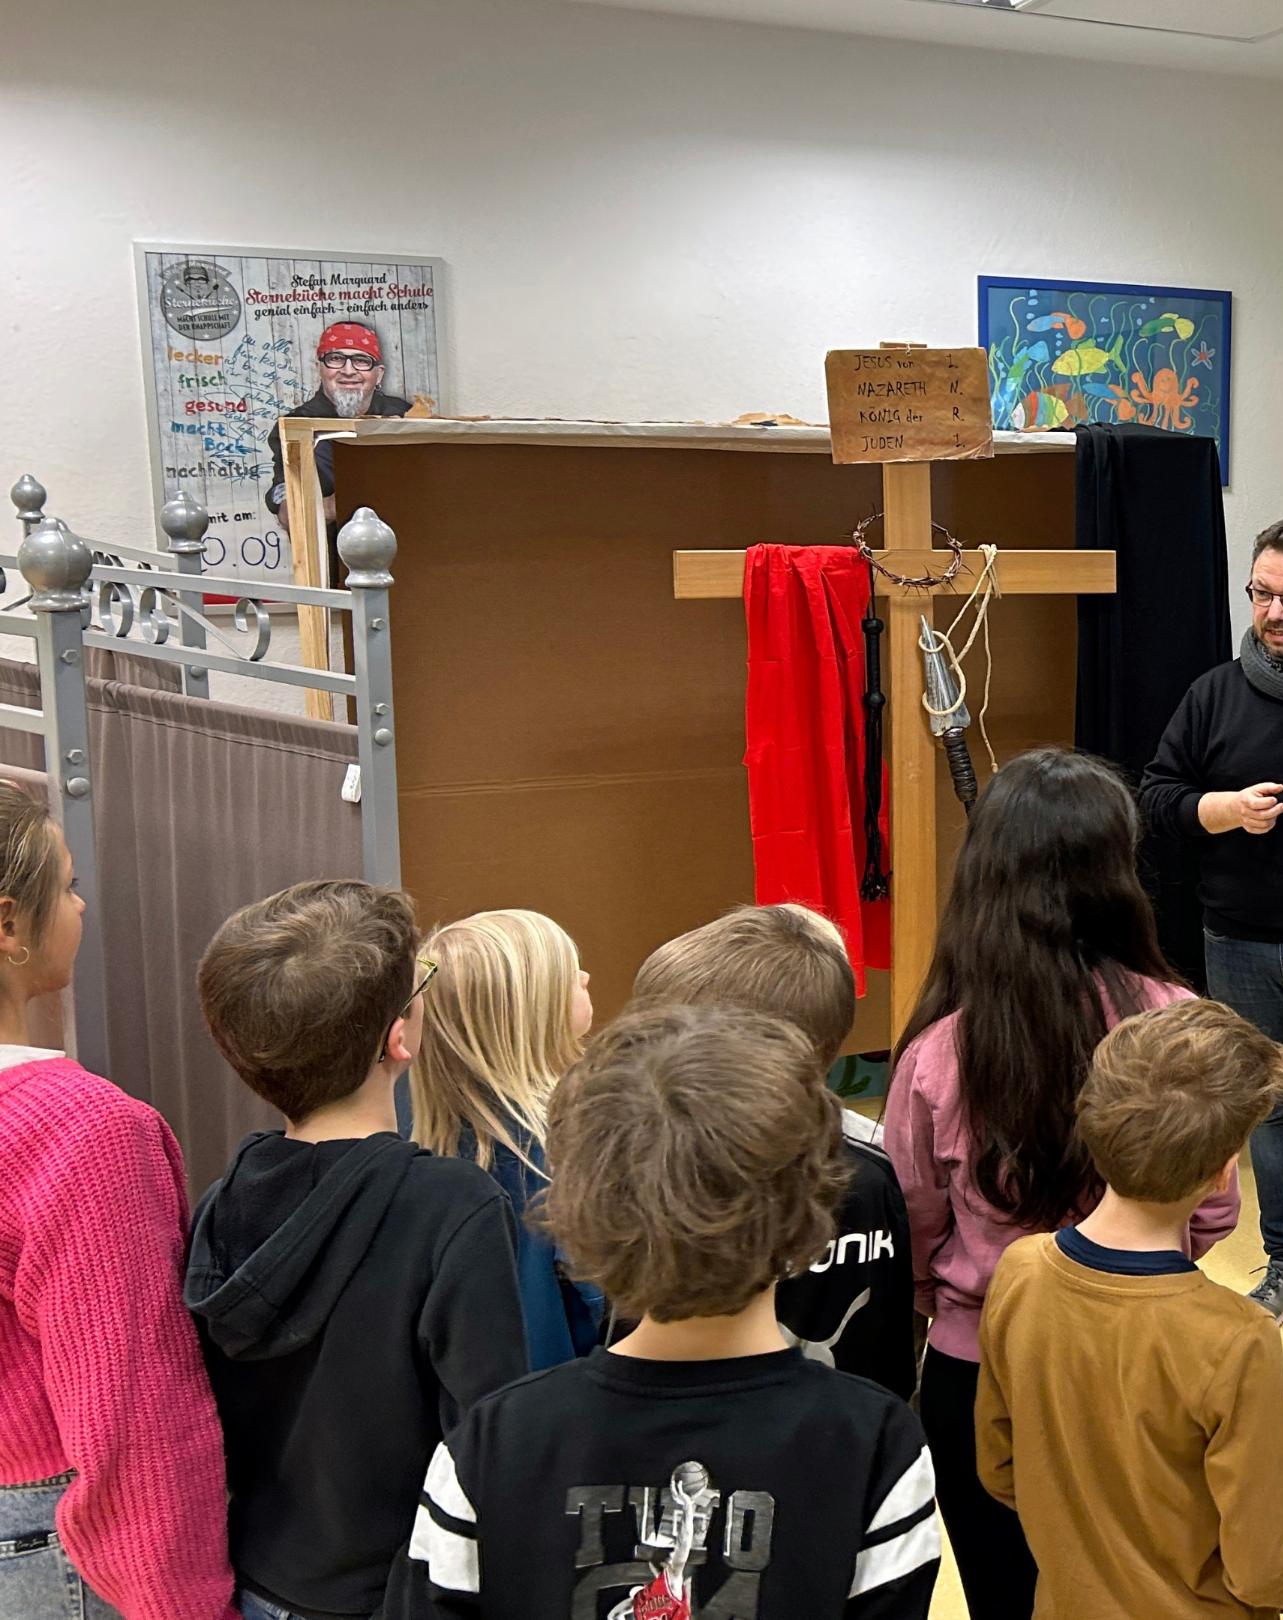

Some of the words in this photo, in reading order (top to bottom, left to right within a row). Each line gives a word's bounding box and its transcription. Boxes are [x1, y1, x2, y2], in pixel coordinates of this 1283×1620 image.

[291, 274, 327, 290] Stefan
[330, 273, 387, 288] Marquard
[245, 288, 336, 306] Sterneküche
[339, 286, 383, 300] macht
[386, 283, 434, 300] Schule
[254, 304, 291, 320] genial
[293, 302, 336, 318] einfach
[346, 301, 387, 316] einfach
[390, 300, 429, 312] anders
[167, 345, 224, 365] lecker
[854, 354, 892, 371] JESUS
[178, 370, 227, 389] frisch
[857, 381, 927, 398] NAZARETH
[185, 398, 247, 416] gesund
[859, 406, 900, 424] KÖNIG
[906, 409, 923, 423] der
[171, 420, 225, 436] macht
[204, 437, 247, 454] Bock
[861, 435, 904, 452] JUDEN
[166, 461, 260, 479] nachhaltig
[234, 511, 256, 522] am:
